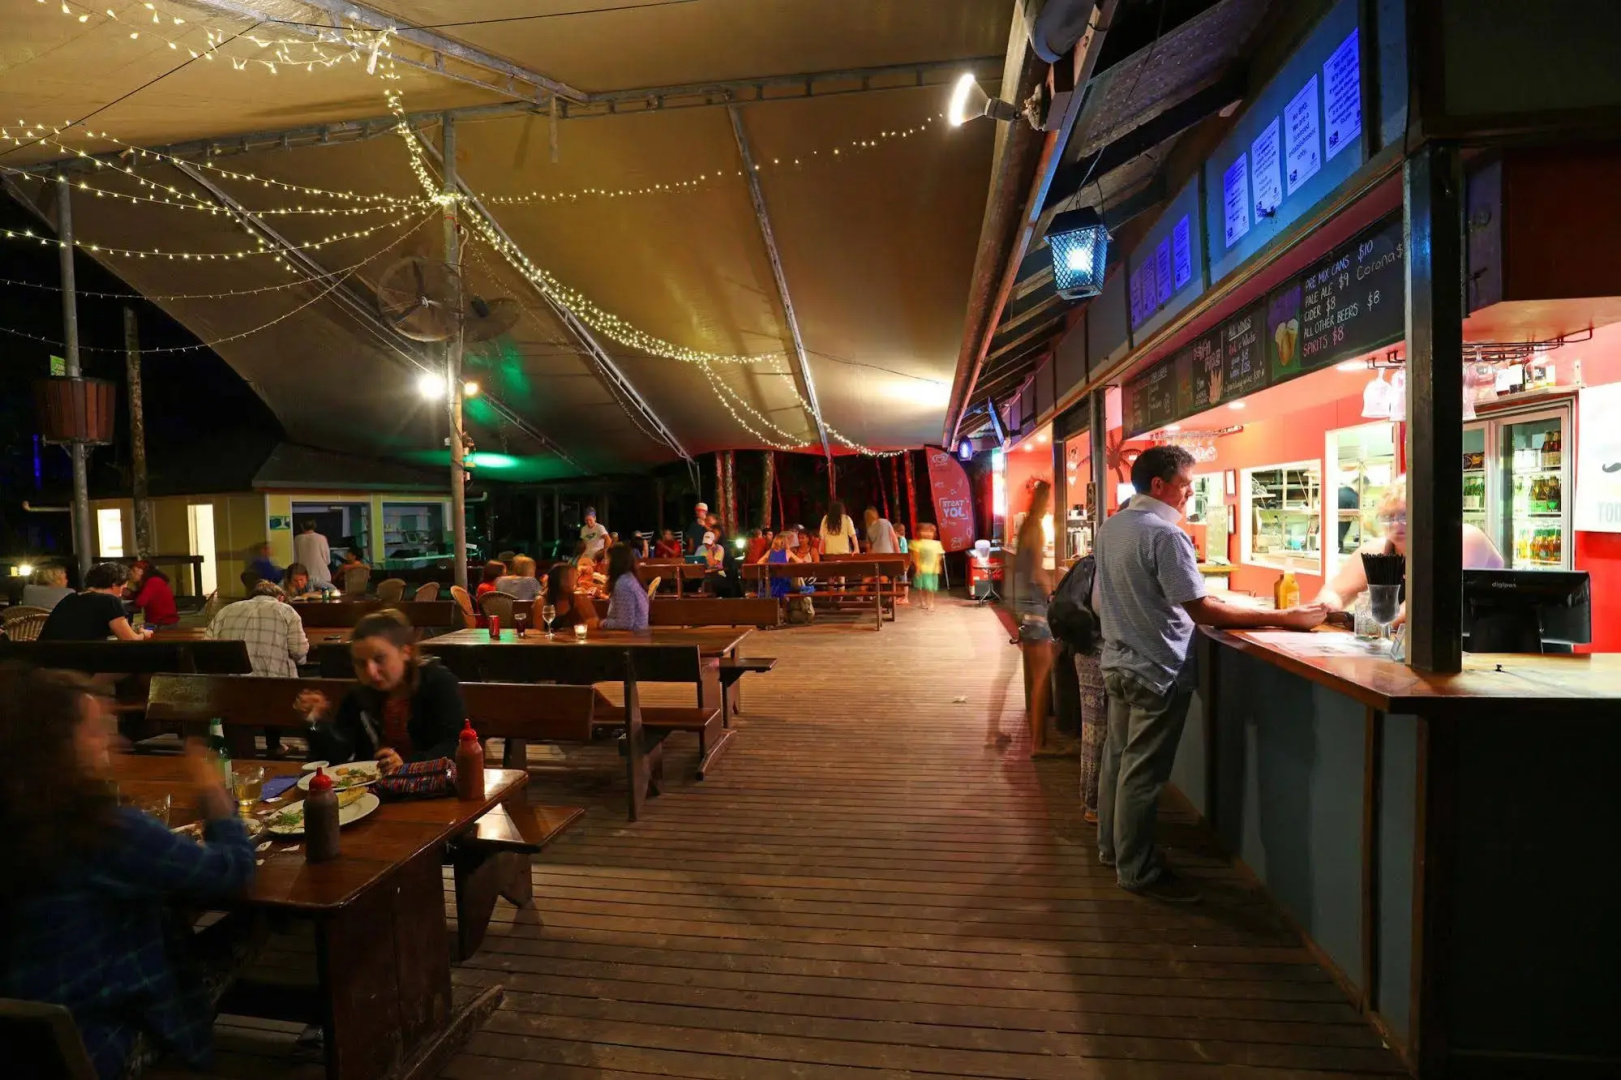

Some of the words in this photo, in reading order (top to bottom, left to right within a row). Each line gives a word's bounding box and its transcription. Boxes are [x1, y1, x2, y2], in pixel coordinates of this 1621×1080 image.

[1305, 275, 1317, 292] PRE
[1318, 268, 1330, 284] MIX
[1331, 254, 1350, 275] CANS
[1357, 239, 1374, 263] $10
[1305, 291, 1319, 308] PALE
[1320, 282, 1333, 300] ALE
[1339, 272, 1349, 291] $9
[1356, 252, 1395, 281] Corona
[1304, 304, 1322, 322] CIDER
[1326, 295, 1336, 317] $8
[1304, 326, 1314, 339] ALL
[1314, 315, 1335, 334] OTHER
[1337, 302, 1358, 323] BEERS
[1367, 289, 1380, 312] $8
[1303, 334, 1328, 357] SPIRITS
[1332, 325, 1344, 346] $8
